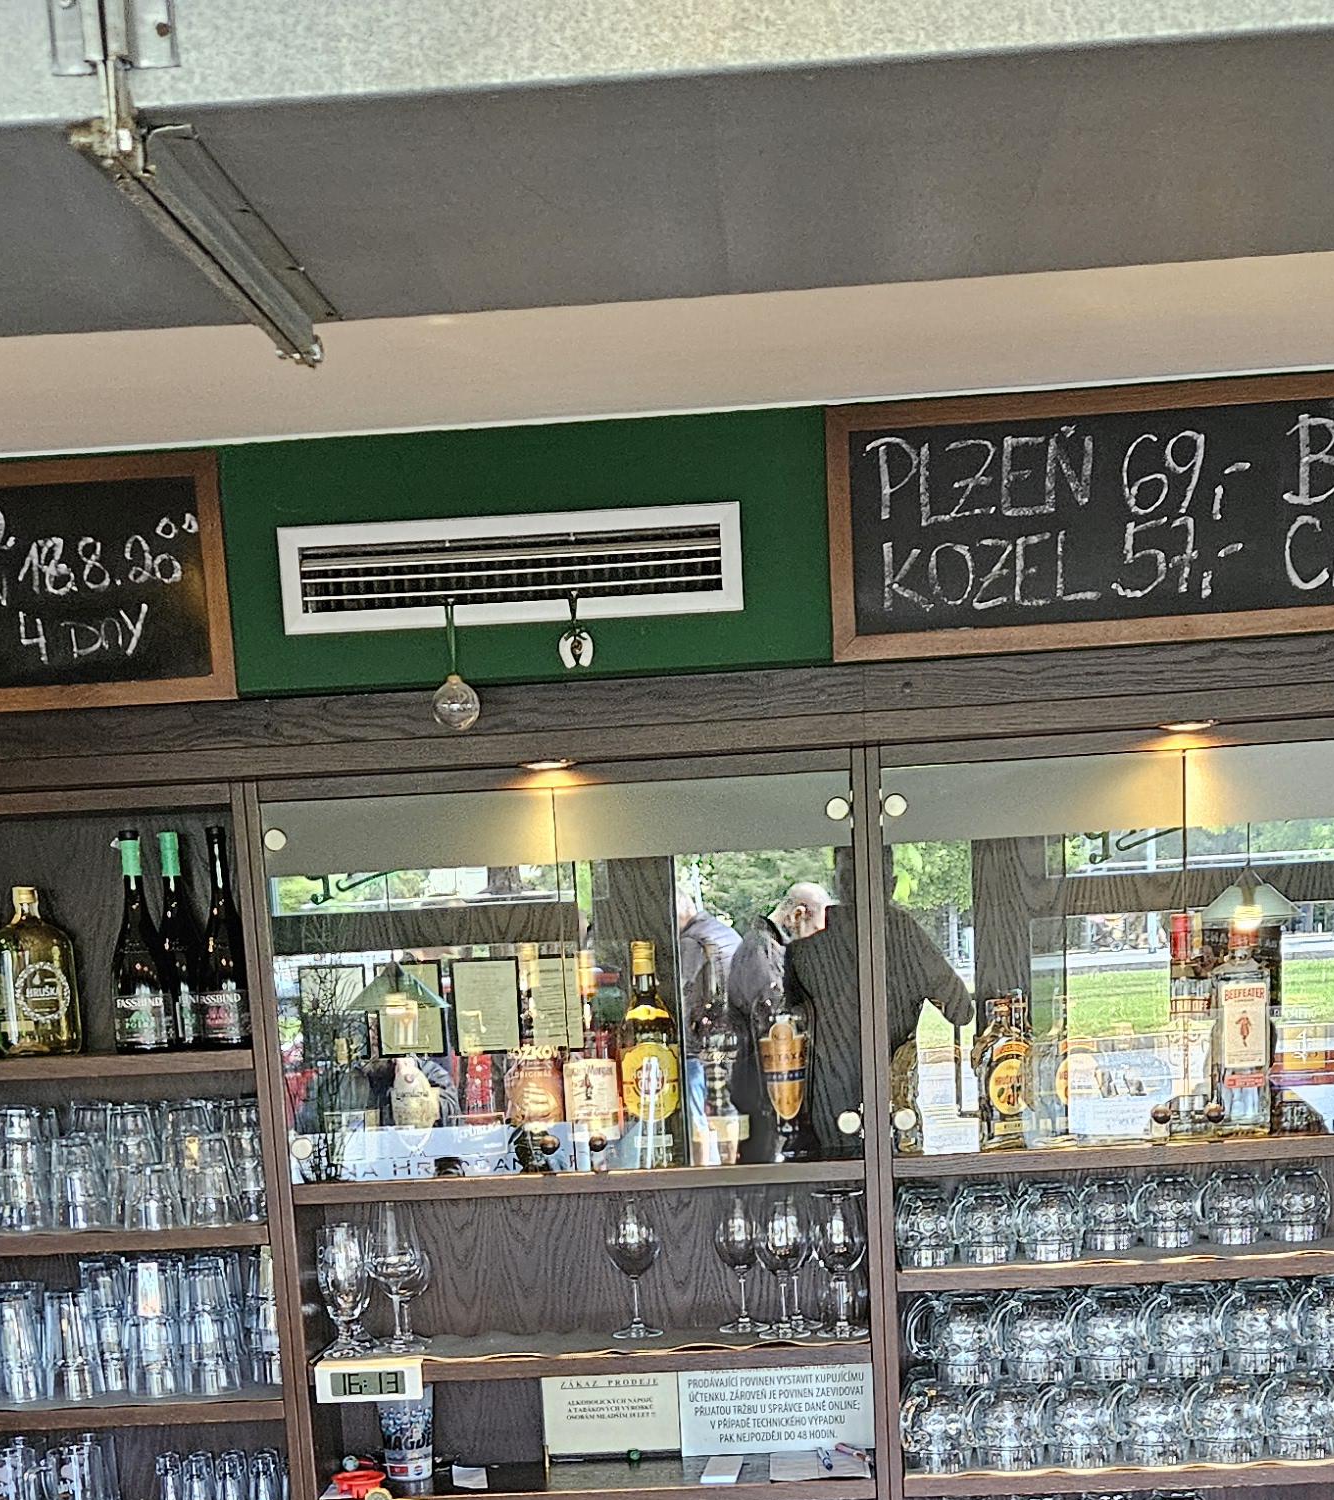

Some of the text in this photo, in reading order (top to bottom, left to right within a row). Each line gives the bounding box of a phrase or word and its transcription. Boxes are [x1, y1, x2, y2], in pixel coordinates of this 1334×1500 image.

[880, 530, 1101, 610] KOZEL
[17, 611, 49, 665] 4
[1224, 987, 1265, 1001] BEEFEATER
[688, 1371, 864, 1389] PRODÁVAJÍCÍ POVINEN VYSTAVIT KUPUJÍCÍMU
[768, 1390, 777, 1400] JE
[779, 1387, 814, 1399] POVINEN
[816, 1385, 864, 1397] ZAEVIDOVAT
[733, 1403, 758, 1415] TRŽBU
[768, 1401, 803, 1414] SPRÁVCE
[807, 1413, 846, 1425] VÝPADKU
[719, 1433, 735, 1443] PAK
[784, 1430, 795, 1440] DO
